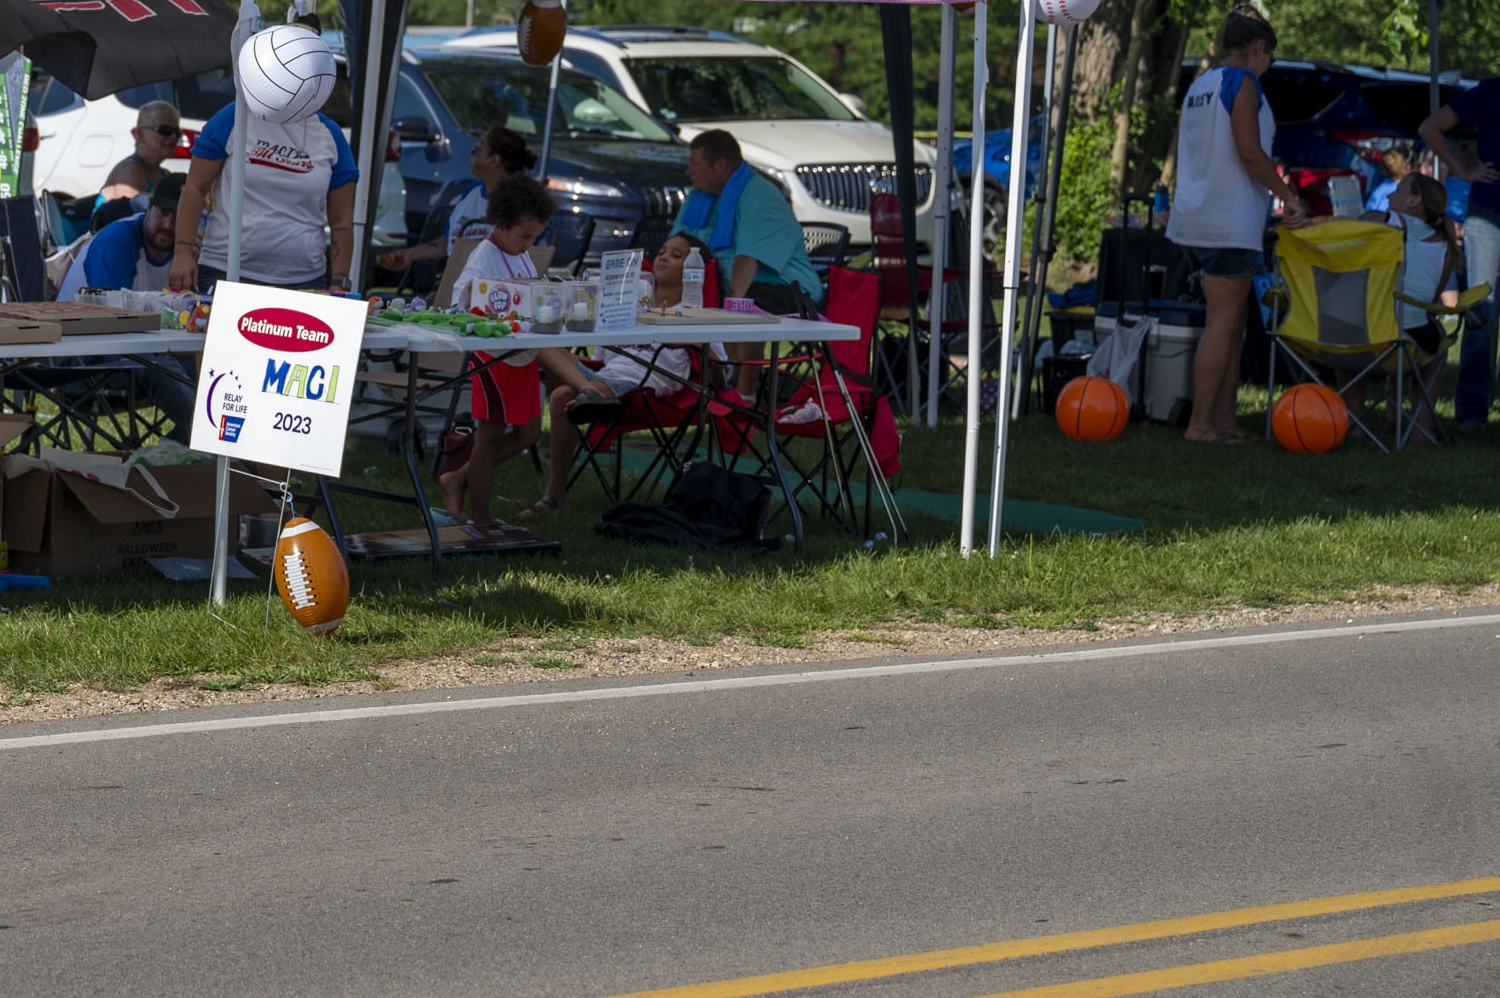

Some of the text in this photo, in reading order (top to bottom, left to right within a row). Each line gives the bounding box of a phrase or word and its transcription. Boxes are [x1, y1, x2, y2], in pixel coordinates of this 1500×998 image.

[21, 73, 31, 93] RED
[19, 93, 29, 119] ZONE
[241, 317, 329, 344] Platinum Team
[262, 358, 340, 404] MACI
[222, 402, 248, 414] FOR LIFE
[224, 392, 243, 403] RELAY
[272, 412, 312, 435] 2023
[116, 541, 178, 556] HALLOWEEN
